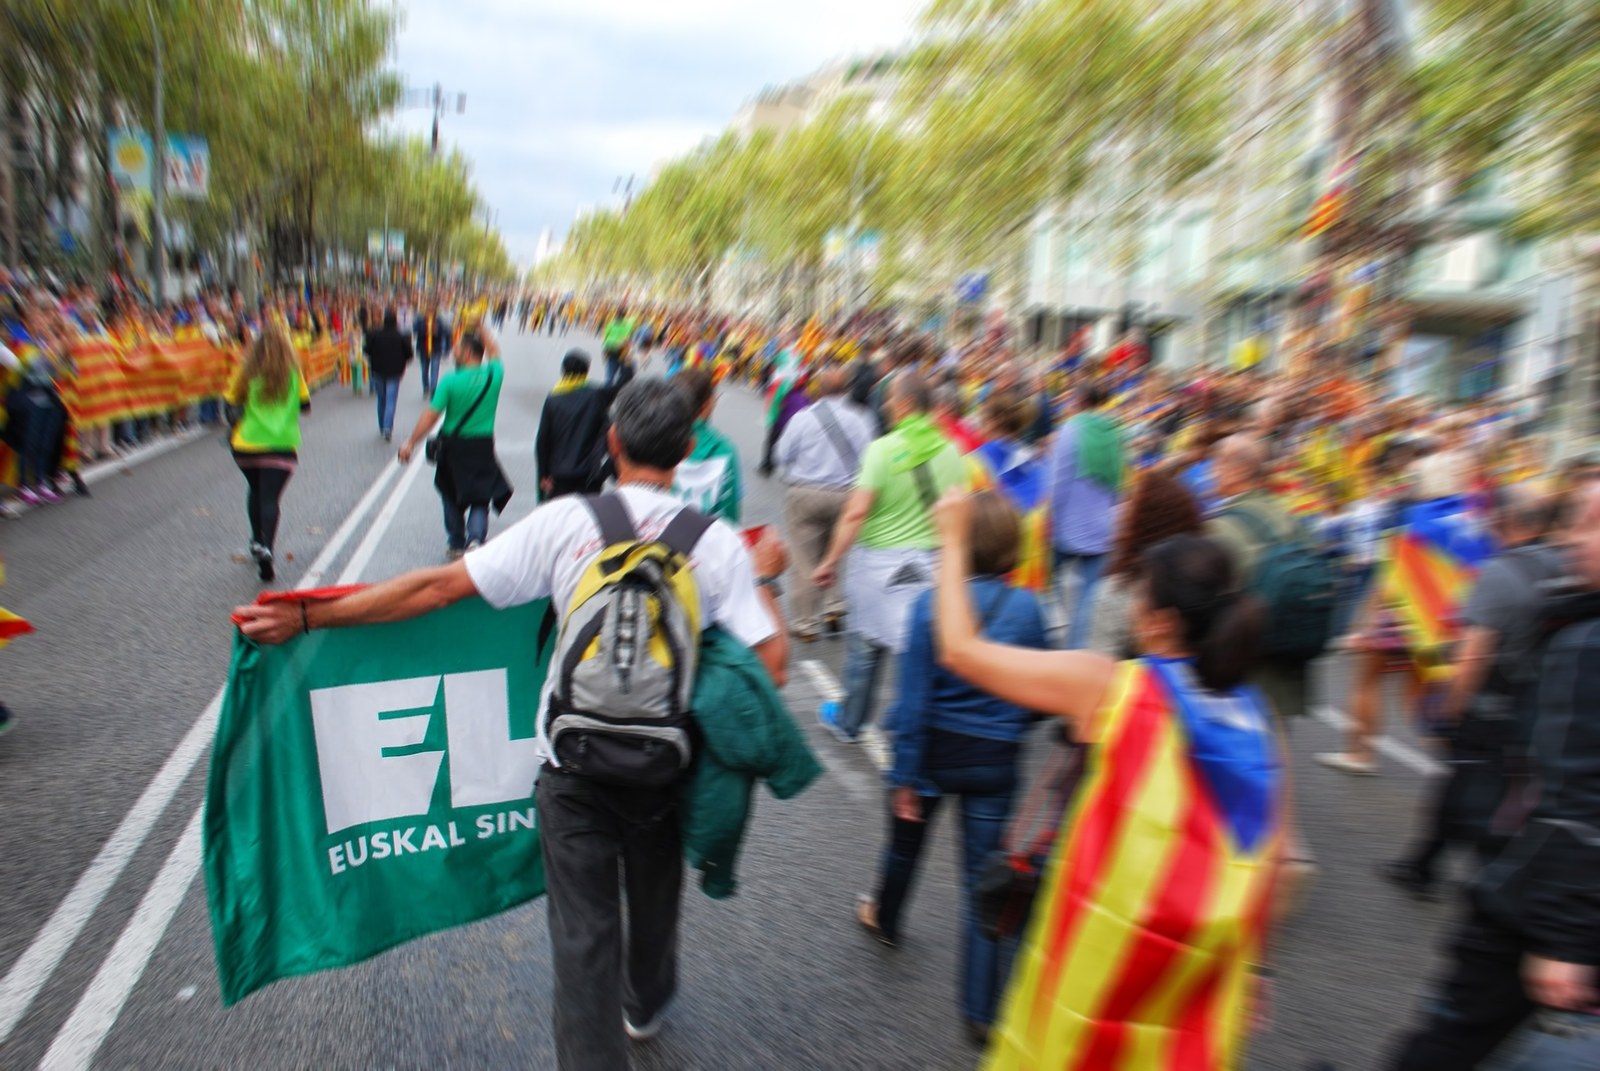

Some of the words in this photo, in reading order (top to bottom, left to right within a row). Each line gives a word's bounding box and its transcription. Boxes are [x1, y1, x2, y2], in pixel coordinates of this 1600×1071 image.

[310, 668, 536, 834] EL
[328, 821, 466, 875] EUSKAL
[475, 807, 536, 839] SIN
